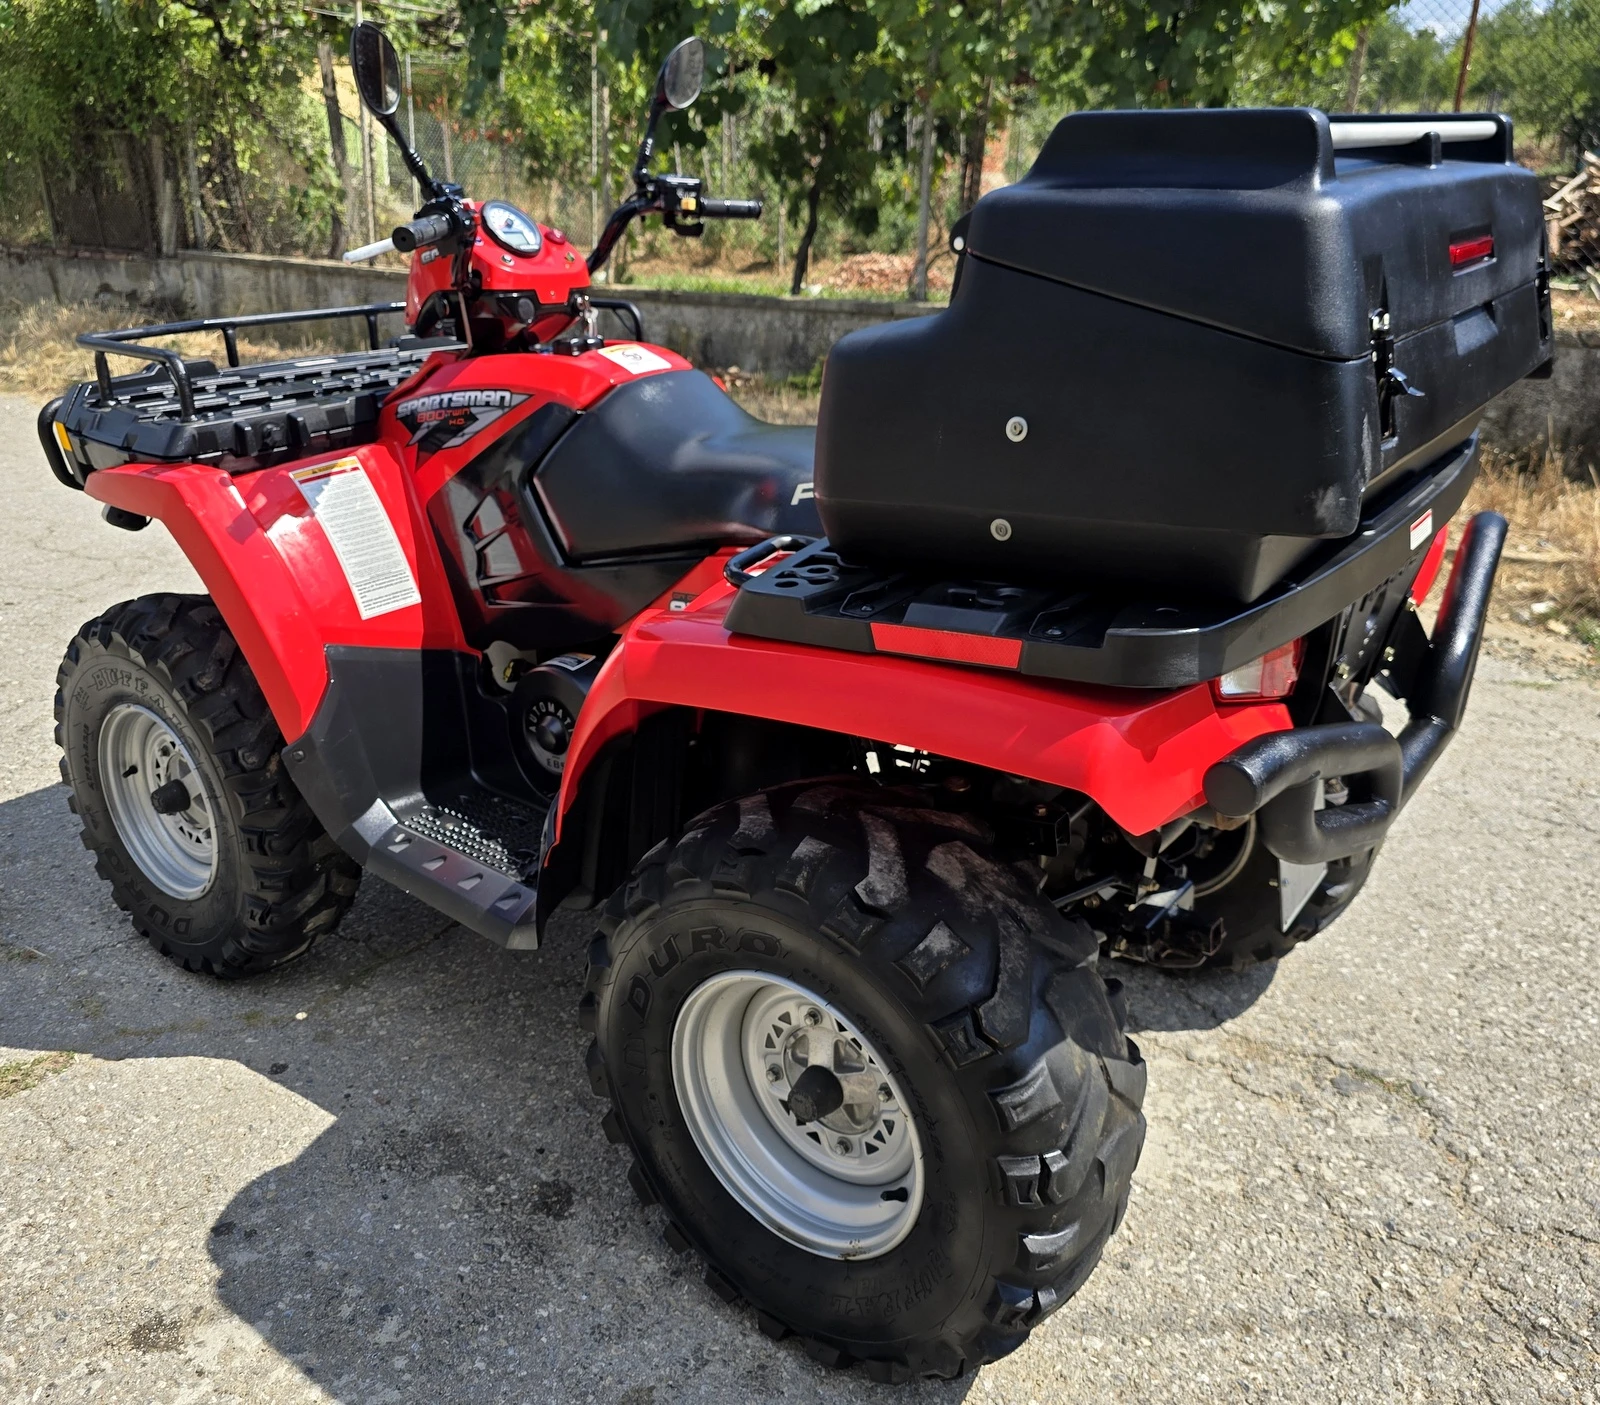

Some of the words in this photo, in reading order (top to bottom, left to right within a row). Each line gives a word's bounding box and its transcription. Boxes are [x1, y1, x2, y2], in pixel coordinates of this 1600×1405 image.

[397, 389, 511, 418] SPORTSMAN
[528, 701, 575, 733] AUTOMATI
[100, 844, 193, 937] DURO
[627, 925, 782, 1023] DURO
